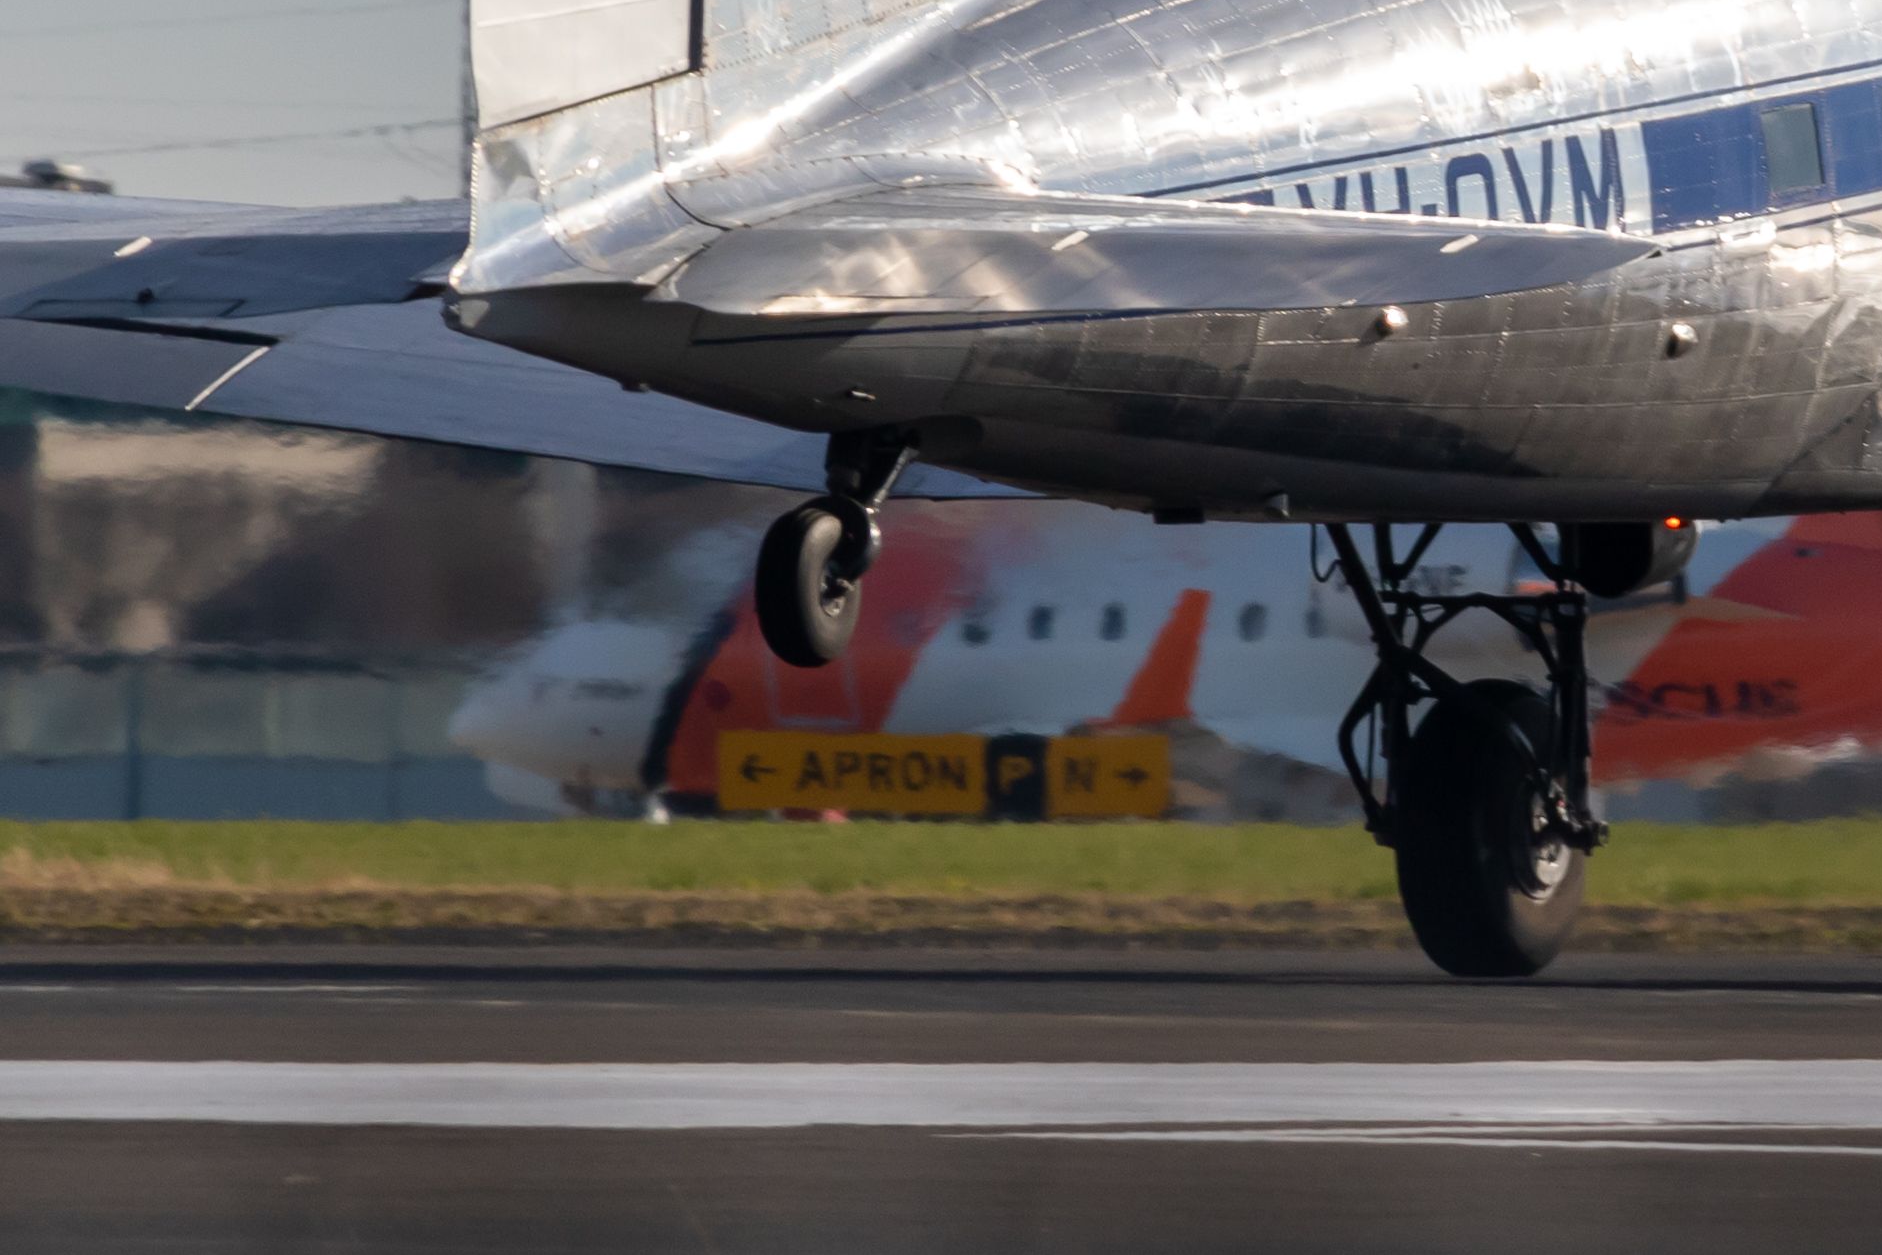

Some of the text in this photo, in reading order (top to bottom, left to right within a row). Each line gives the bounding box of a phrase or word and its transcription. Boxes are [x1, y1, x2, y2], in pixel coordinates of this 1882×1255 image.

[793, 750, 1098, 795] APRON P N
